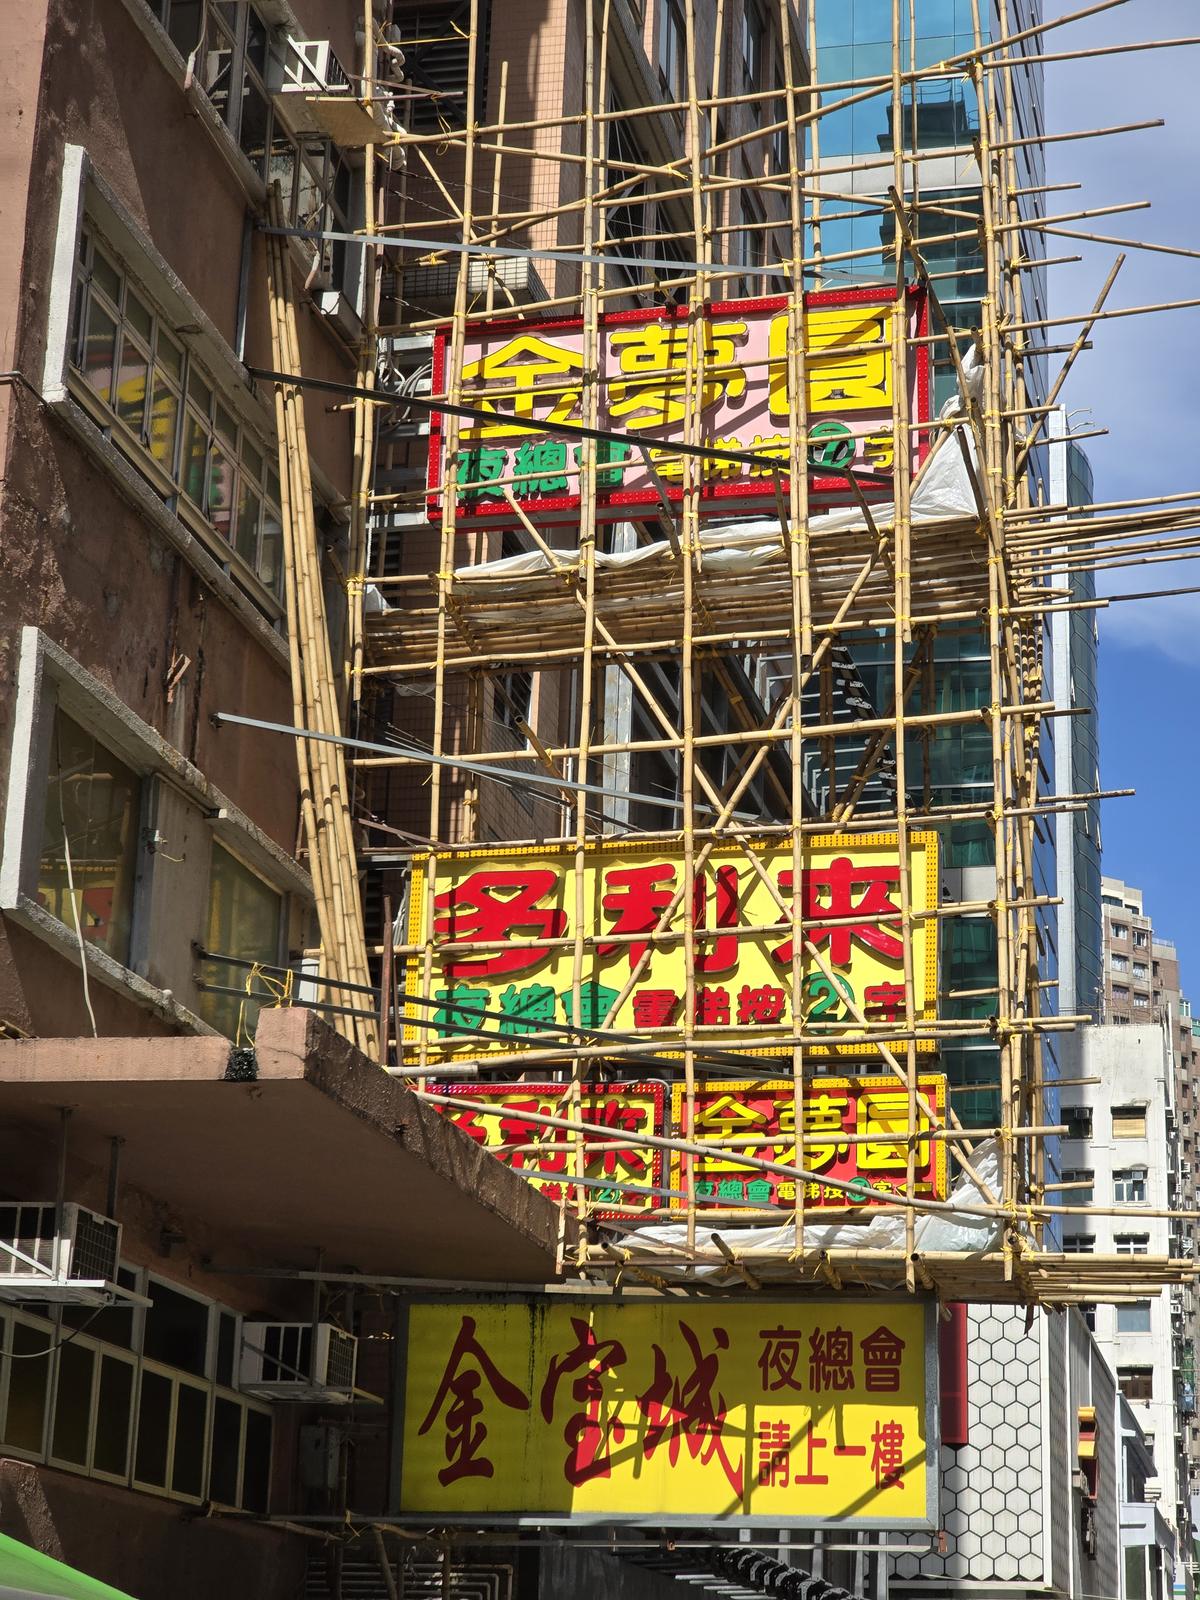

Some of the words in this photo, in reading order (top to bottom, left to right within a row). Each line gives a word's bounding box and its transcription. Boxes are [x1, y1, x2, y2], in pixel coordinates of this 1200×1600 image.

[434, 856, 906, 978] 多利來
[433, 981, 622, 1038] 夜總會
[694, 1178, 772, 1203] 夜總會
[757, 1324, 905, 1393] 夜總會
[757, 1419, 905, 1490] 請上一樓
